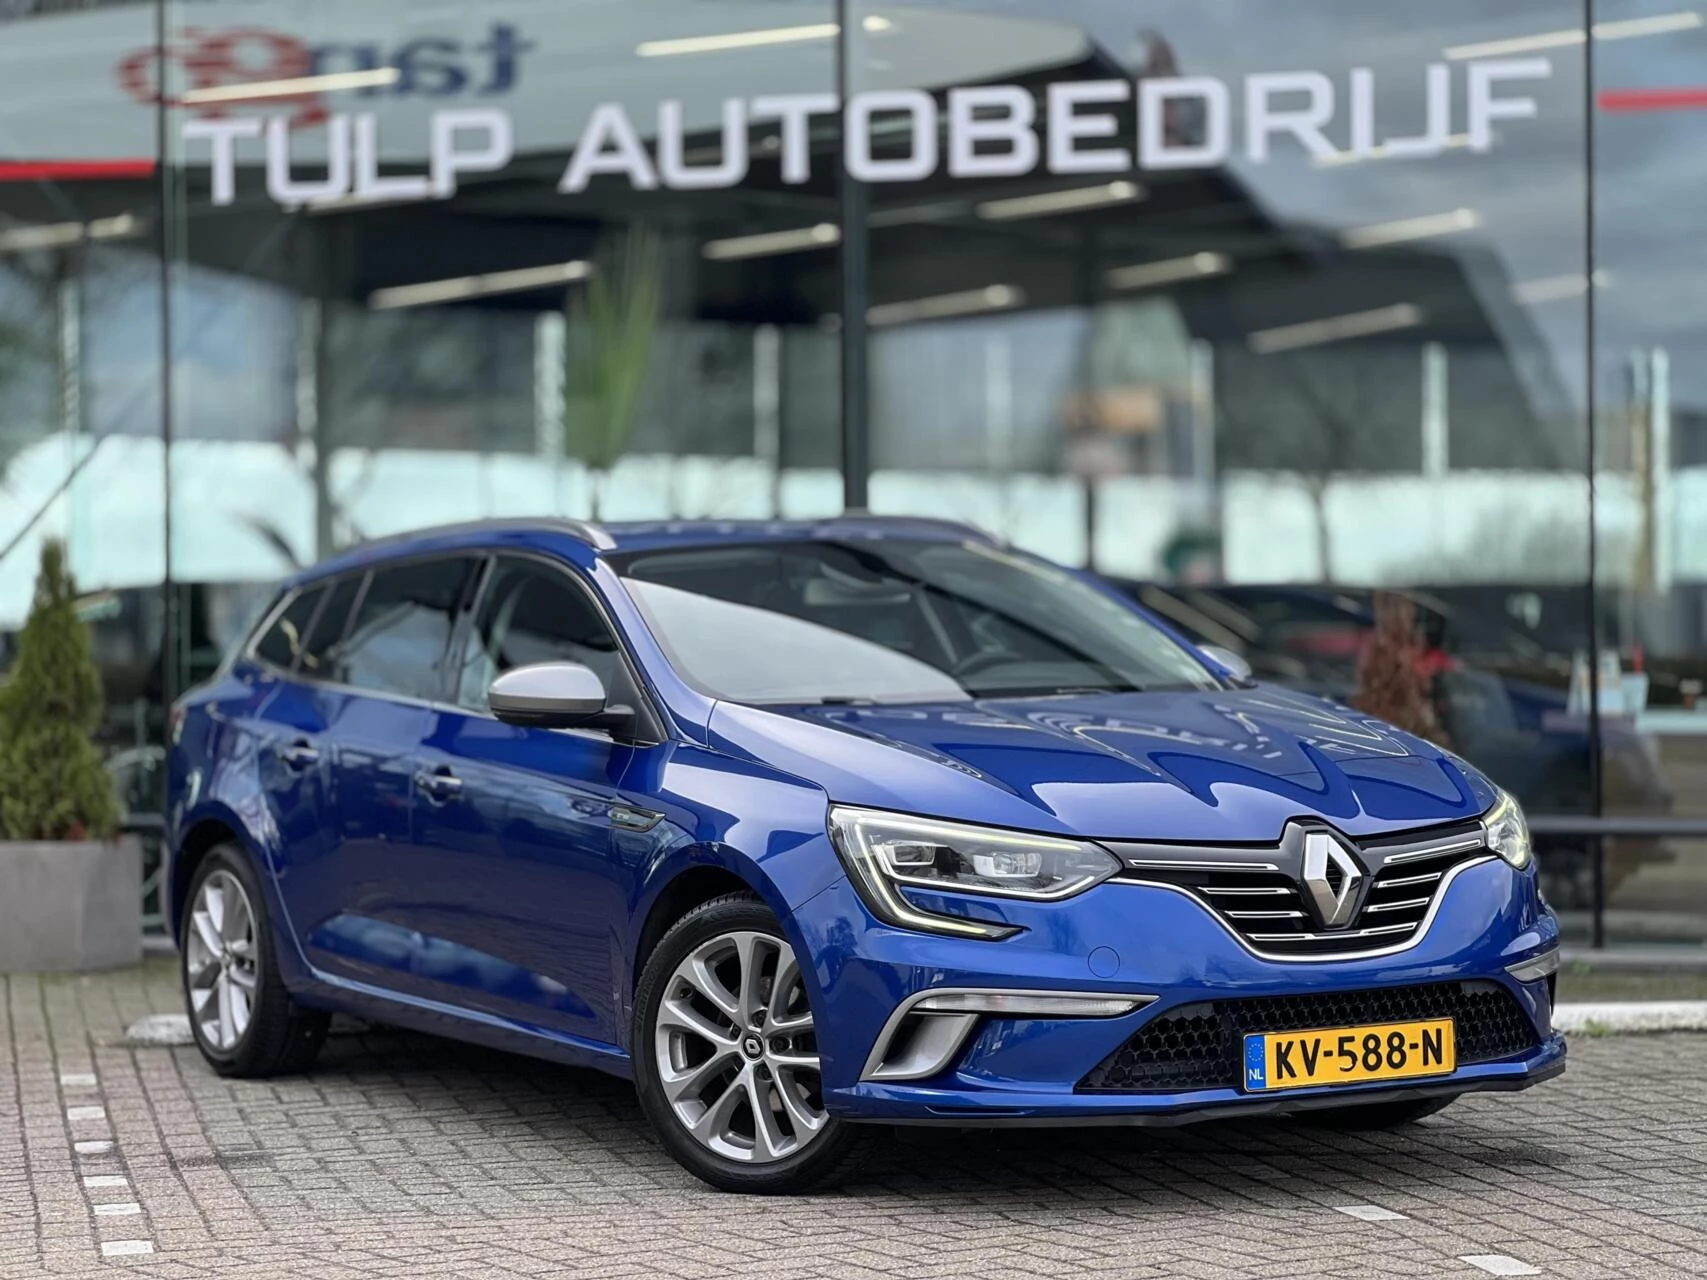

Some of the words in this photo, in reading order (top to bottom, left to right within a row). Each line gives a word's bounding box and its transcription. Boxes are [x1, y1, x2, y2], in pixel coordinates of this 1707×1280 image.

[183, 109, 514, 206] TULP
[560, 57, 1552, 195] AUTOBEDRIJF
[1248, 1069, 1264, 1080] NL
[1276, 1028, 1443, 1080] KV-588-N
